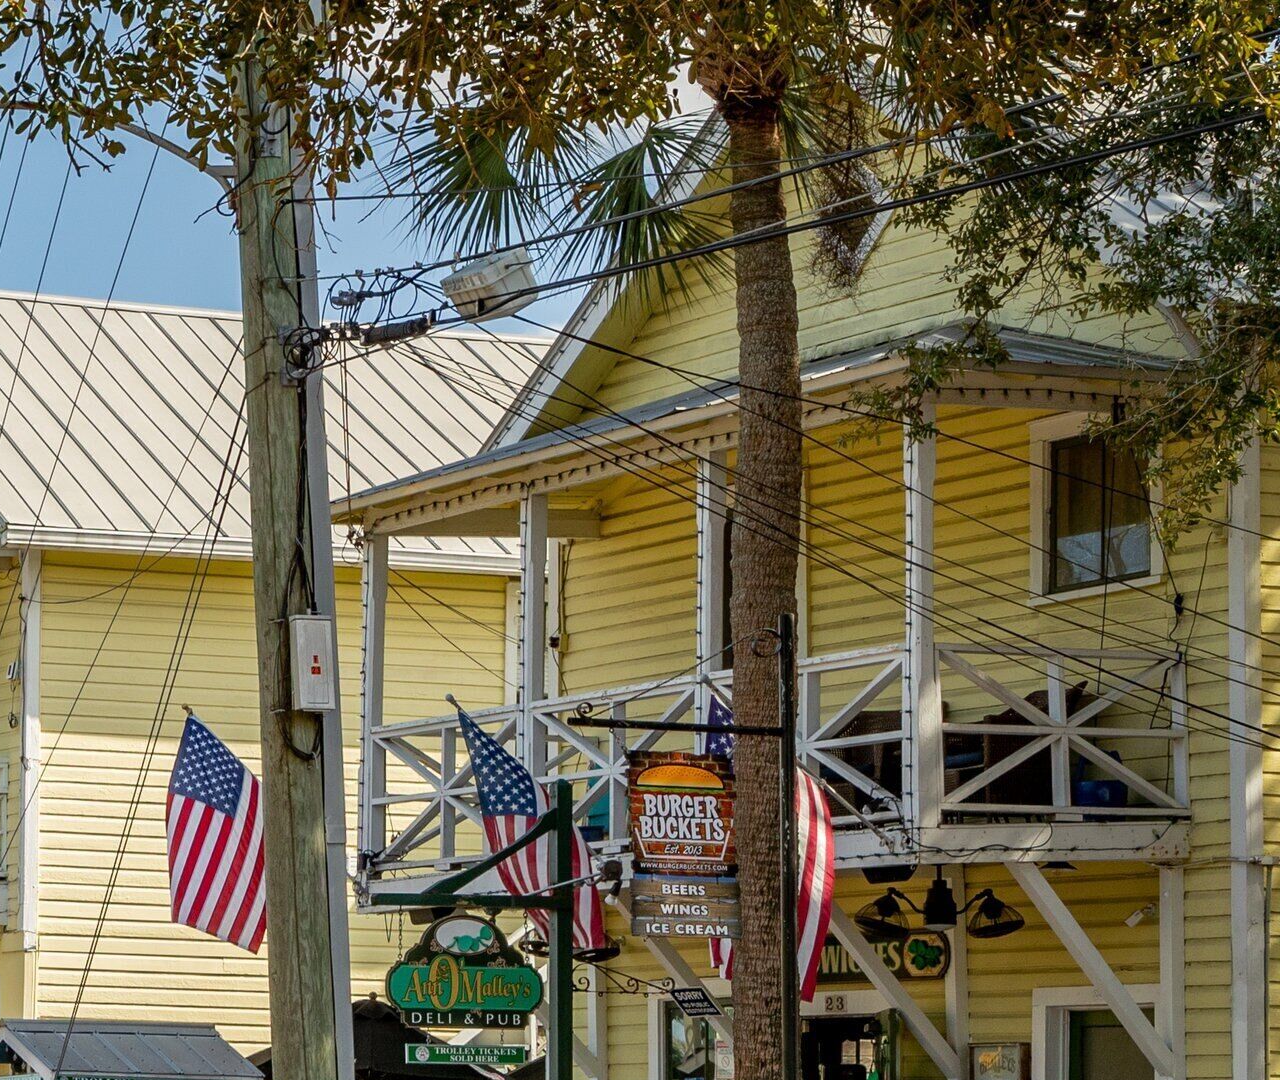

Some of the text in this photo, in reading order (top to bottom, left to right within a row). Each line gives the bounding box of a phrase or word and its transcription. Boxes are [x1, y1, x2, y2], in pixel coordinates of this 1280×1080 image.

[643, 793, 719, 818] BURGER
[640, 816, 725, 841] BUCKETS
[664, 843, 703, 856] Est. 2013
[640, 862, 728, 872] WWW.BURGERBUCKETS.COM
[661, 884, 706, 896] BEERS
[660, 904, 709, 916] WINGS
[646, 922, 729, 936] ICE CREAM
[674, 991, 704, 1001] SORRY
[825, 996, 844, 1011] 23
[411, 1011, 521, 1026] DELI & PUB
[434, 1046, 517, 1056] TROLLEY TICKETS
[449, 1054, 500, 1063] SOLD HERE
